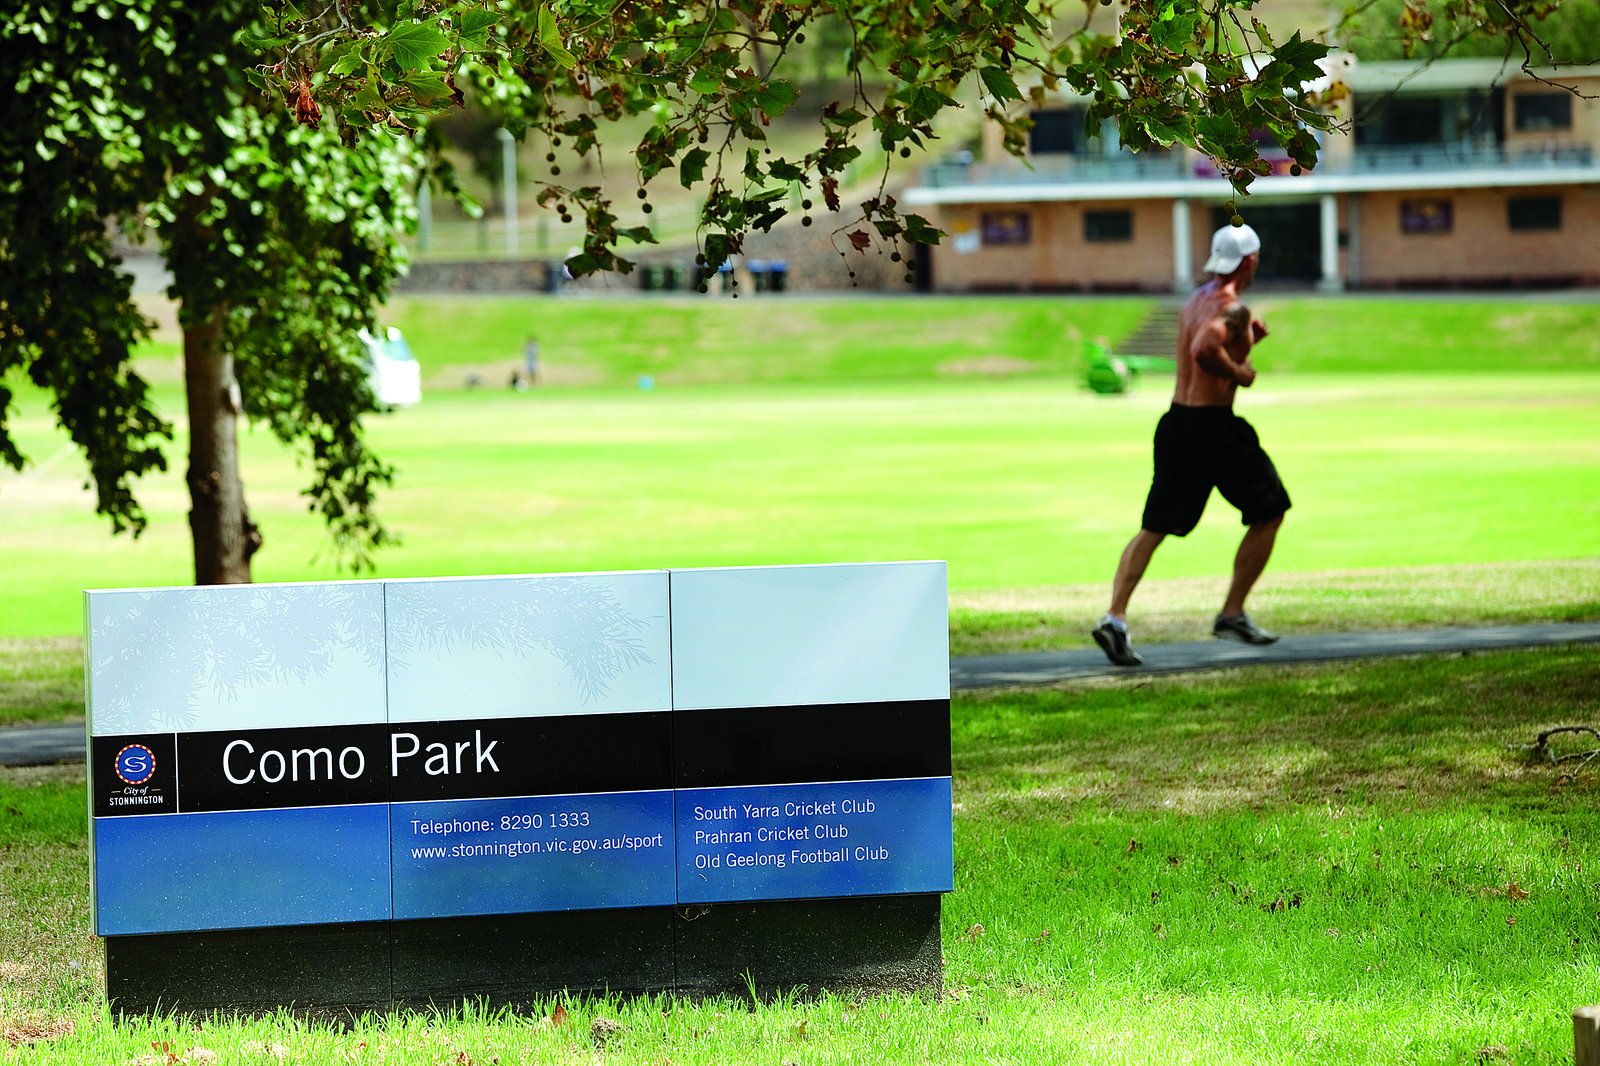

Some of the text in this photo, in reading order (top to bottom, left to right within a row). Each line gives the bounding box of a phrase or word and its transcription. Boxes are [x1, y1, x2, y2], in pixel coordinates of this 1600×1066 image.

[222, 729, 500, 785] Como Park
[109, 795, 163, 806] STONNINGTON
[123, 785, 149, 796] City of
[694, 799, 875, 821] South Yarra Cricket Club
[411, 812, 590, 836] Telephone: 8290 1333
[695, 824, 848, 845] Prahran Cricket Club
[411, 833, 663, 859] www.stonnington.vic.gov.au/sport
[695, 846, 889, 869] Old Geelong Football Club
